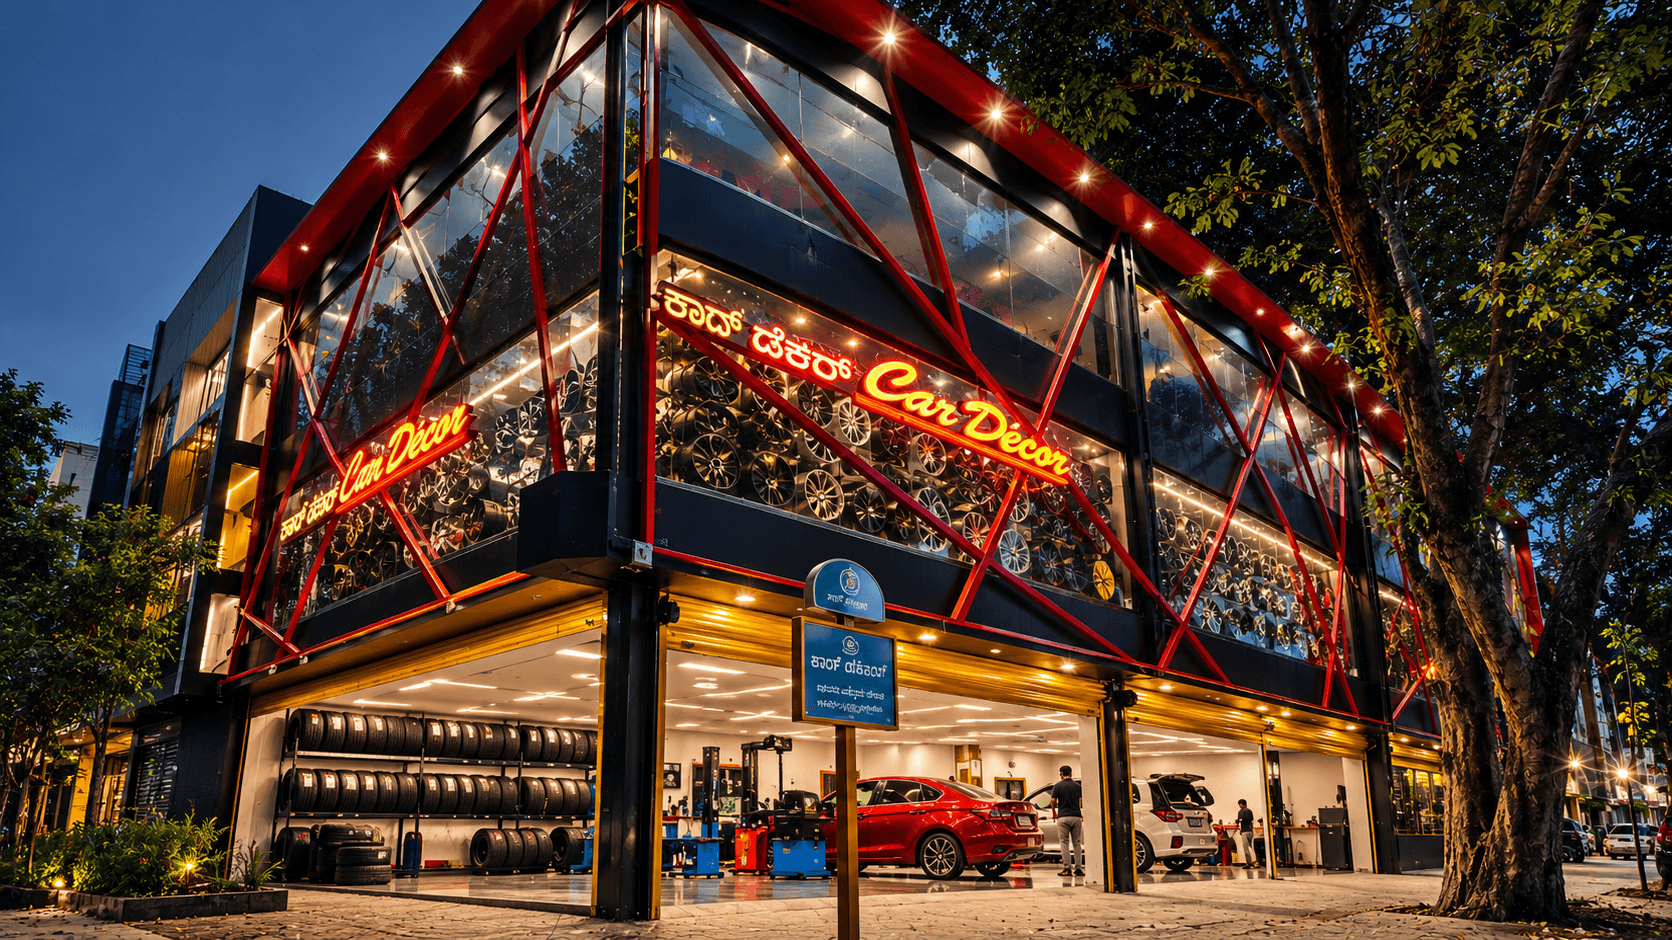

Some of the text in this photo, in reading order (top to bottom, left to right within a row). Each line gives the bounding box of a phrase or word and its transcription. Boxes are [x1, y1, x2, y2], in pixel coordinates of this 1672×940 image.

[386, 404, 468, 474] Décor
[865, 361, 1071, 475] Car Décor
